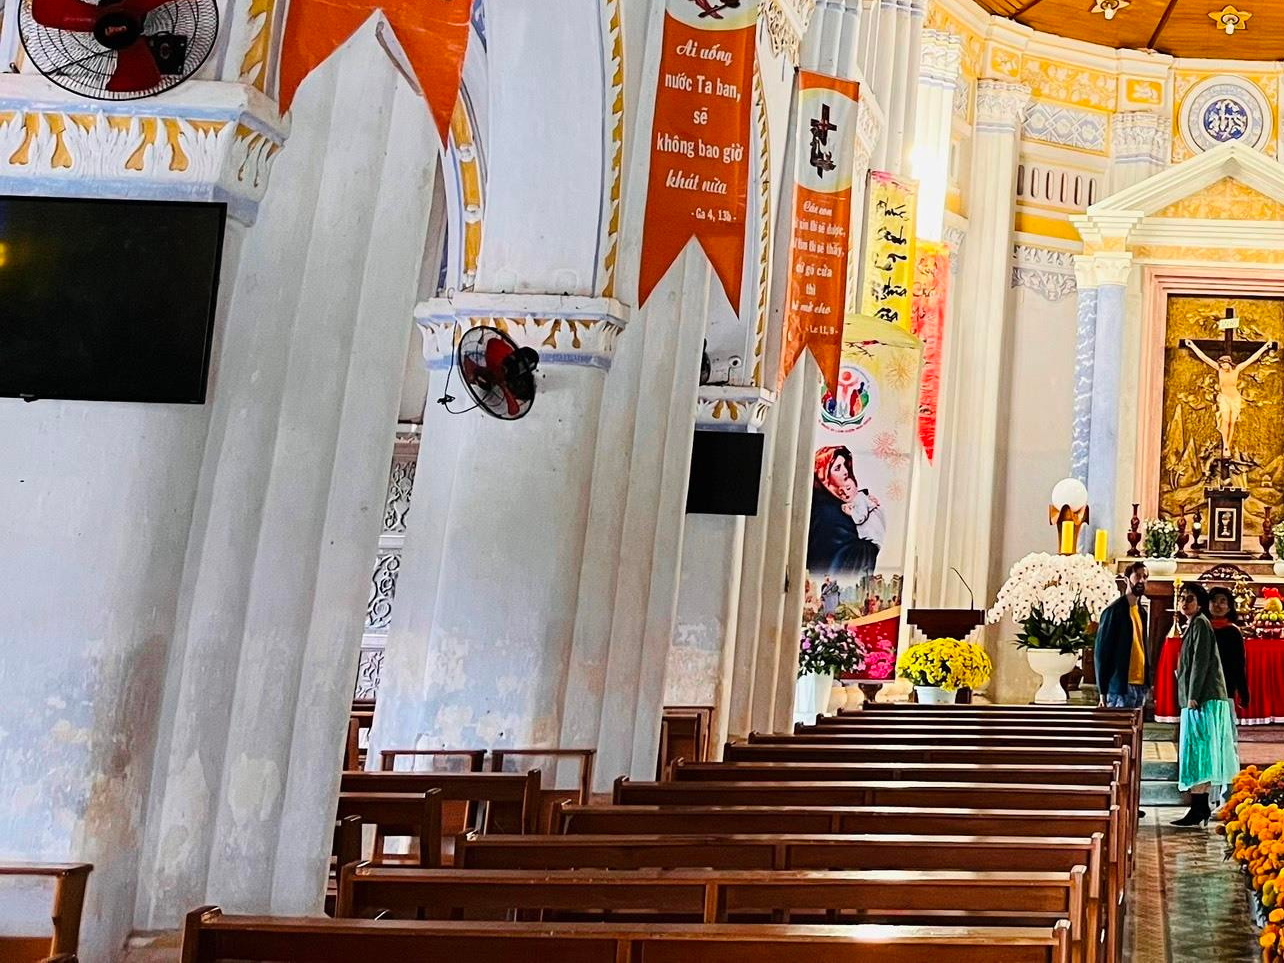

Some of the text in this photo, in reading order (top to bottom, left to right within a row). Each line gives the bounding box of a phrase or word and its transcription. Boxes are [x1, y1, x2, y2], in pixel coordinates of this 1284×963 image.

[676, 39, 733, 66] Ai uống
[665, 72, 741, 102] nước Ta ban,
[693, 107, 708, 125] sẽ
[656, 132, 744, 164] không bao giờ
[666, 169, 727, 195] khát nữa
[695, 208, 706, 220] Ga
